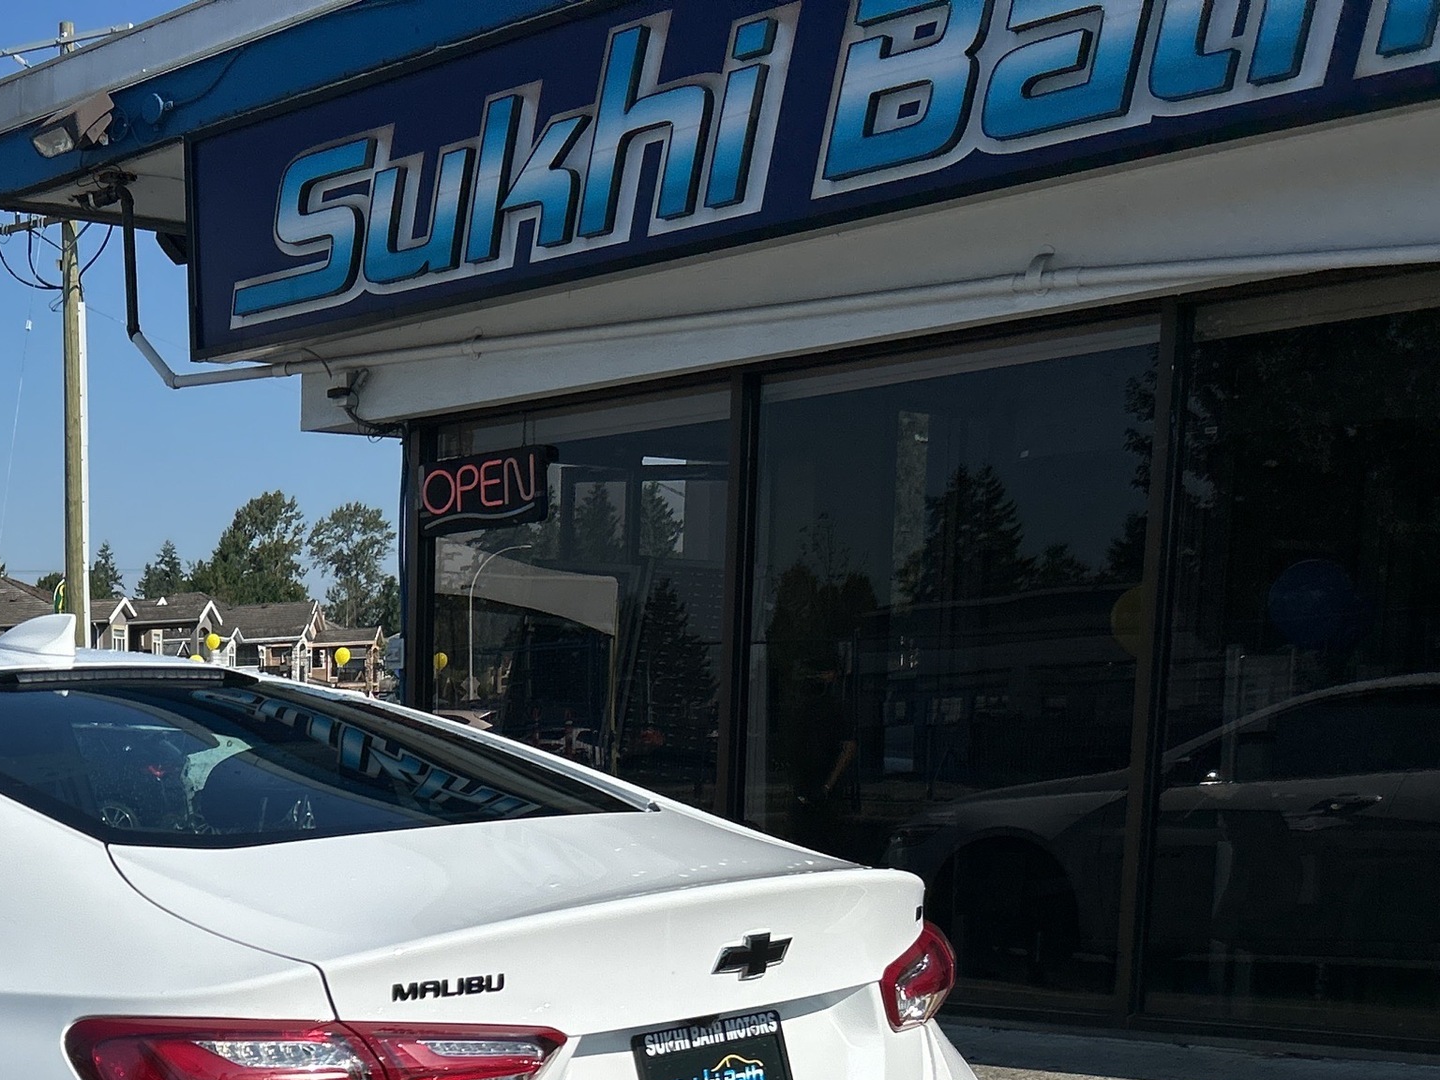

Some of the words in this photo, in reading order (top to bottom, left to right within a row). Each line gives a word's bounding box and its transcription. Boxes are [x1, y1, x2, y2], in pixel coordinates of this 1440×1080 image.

[232, 14, 782, 318] Sukhi
[422, 453, 537, 515] OPEN
[392, 973, 505, 1002] MALIBU
[644, 1029, 691, 1056] SUKHI
[691, 1021, 725, 1048] BATH
[725, 1012, 778, 1041] MOTORS
